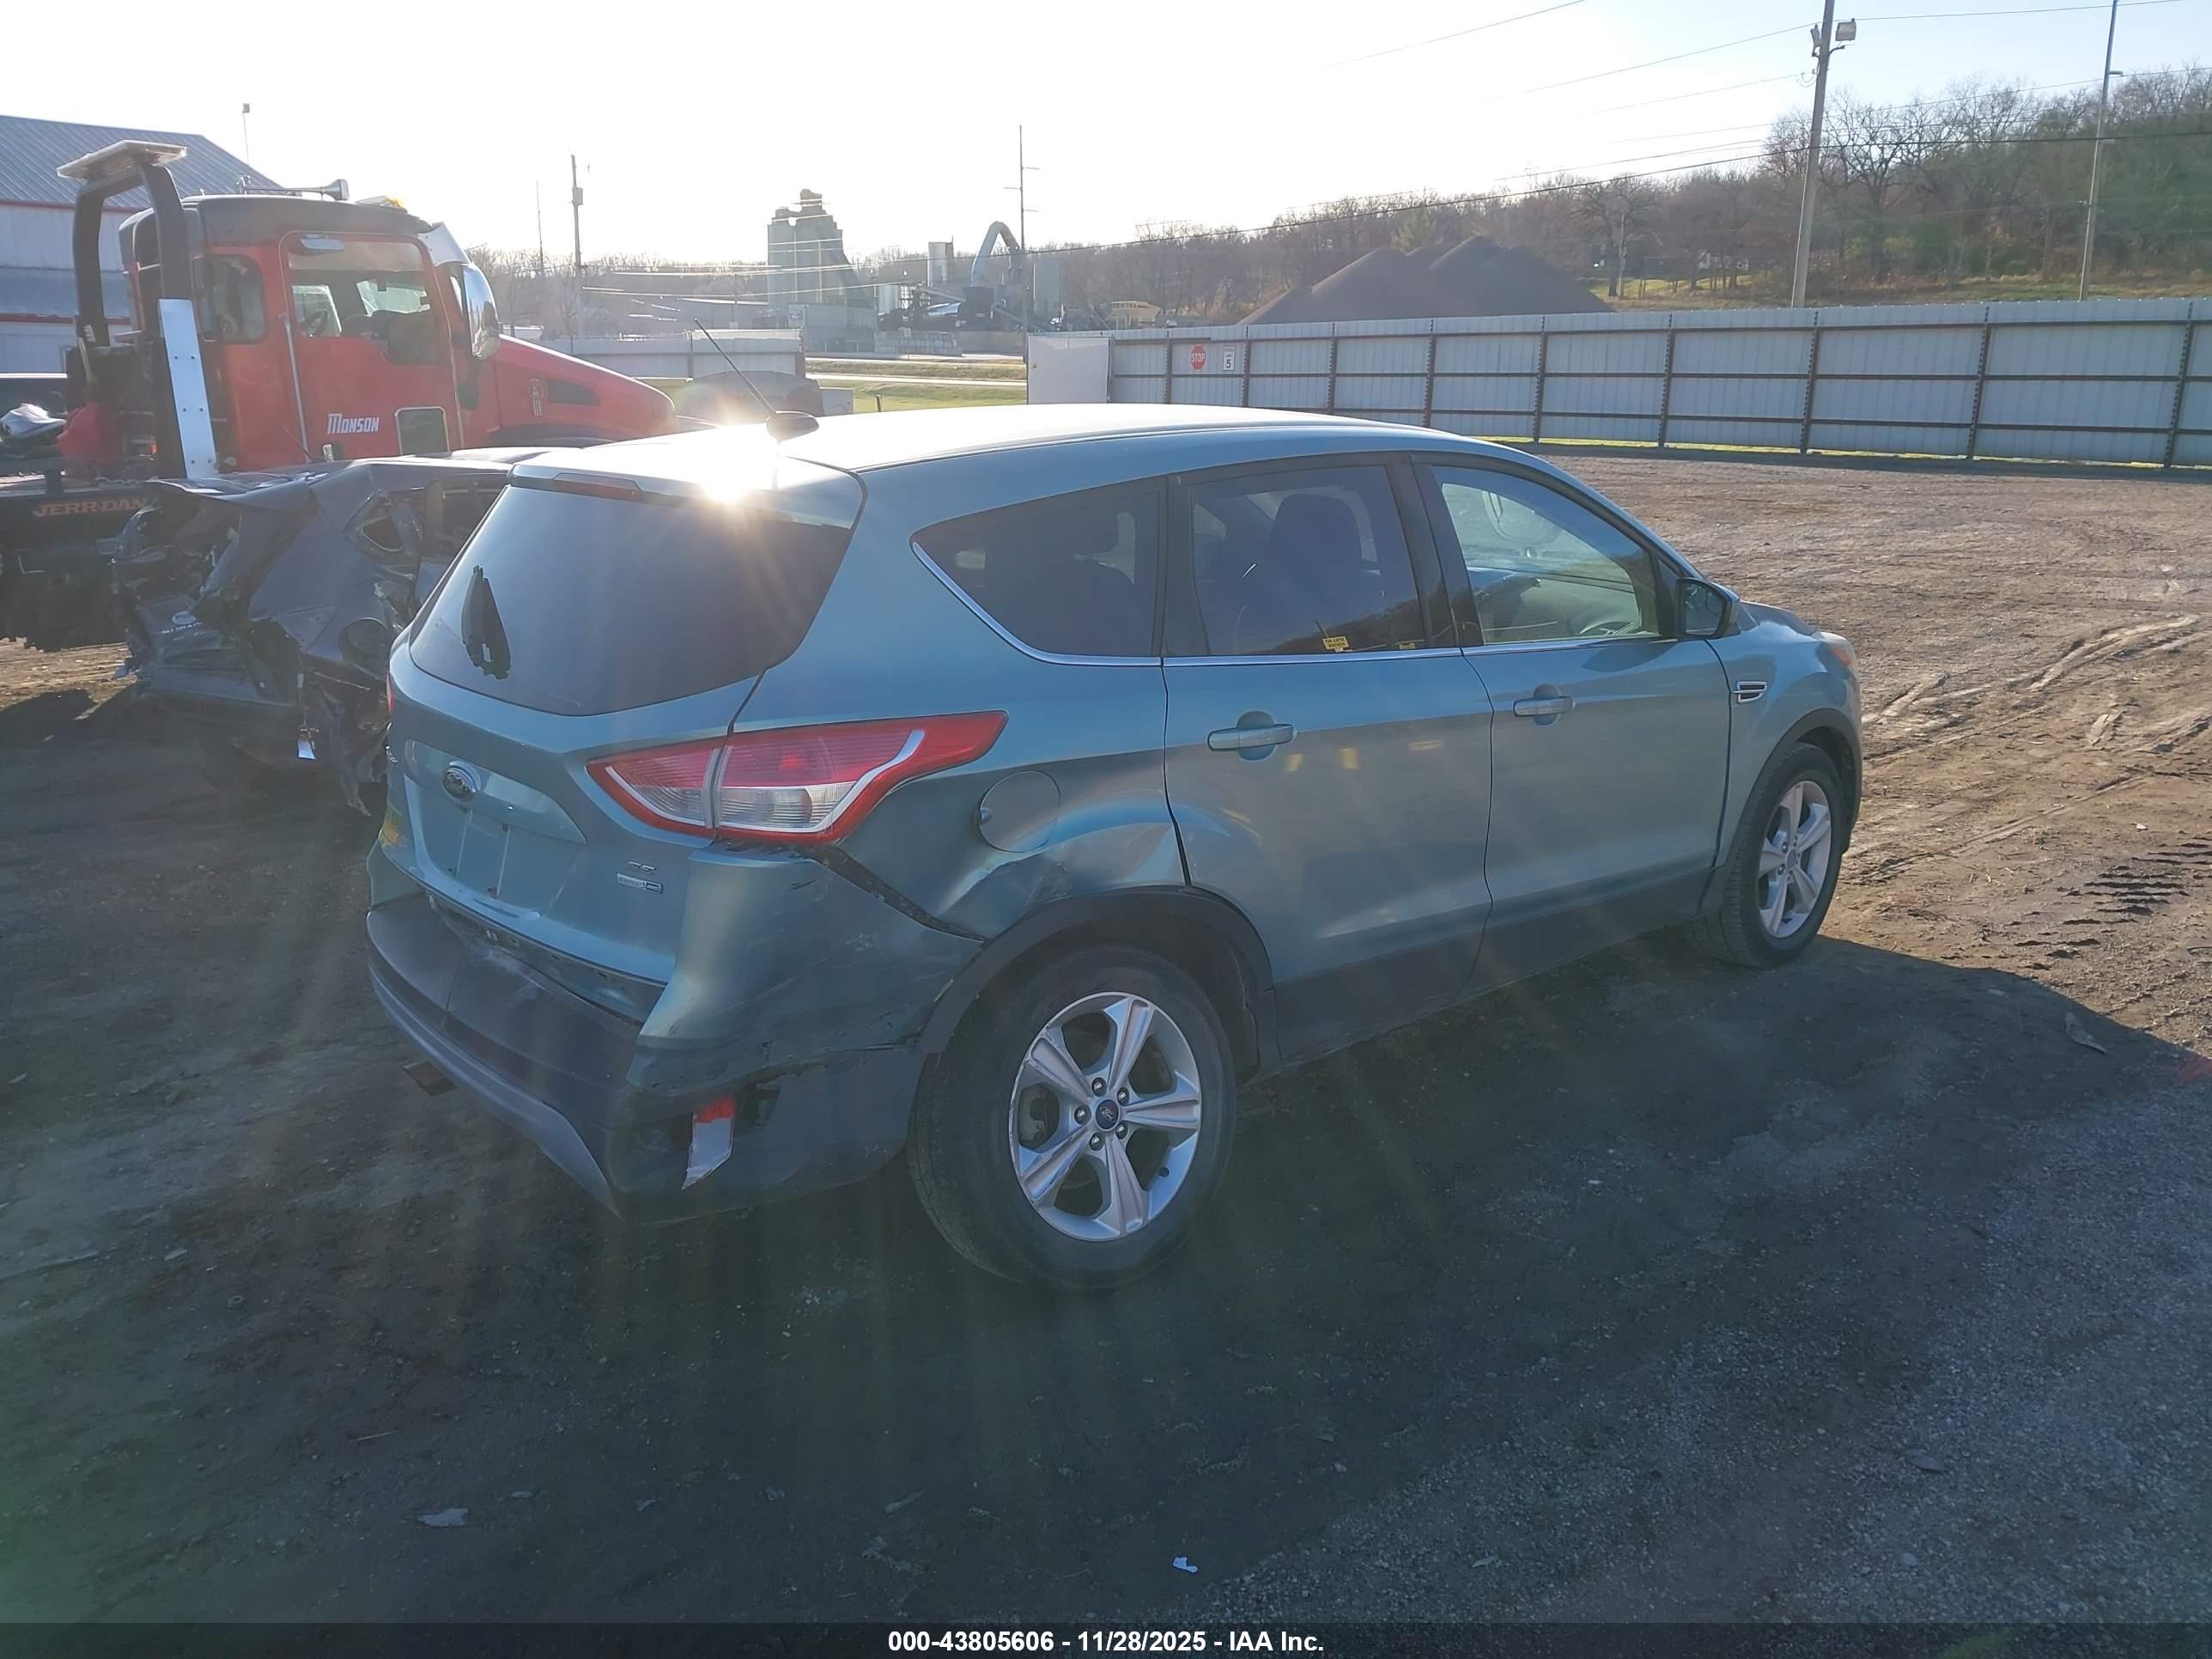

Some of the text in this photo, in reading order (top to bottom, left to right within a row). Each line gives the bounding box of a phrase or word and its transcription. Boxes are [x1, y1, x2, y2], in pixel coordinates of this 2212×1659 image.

[1191, 353, 1206, 363] STOP
[1225, 358, 1231, 369] 5
[327, 413, 380, 434] MONSON
